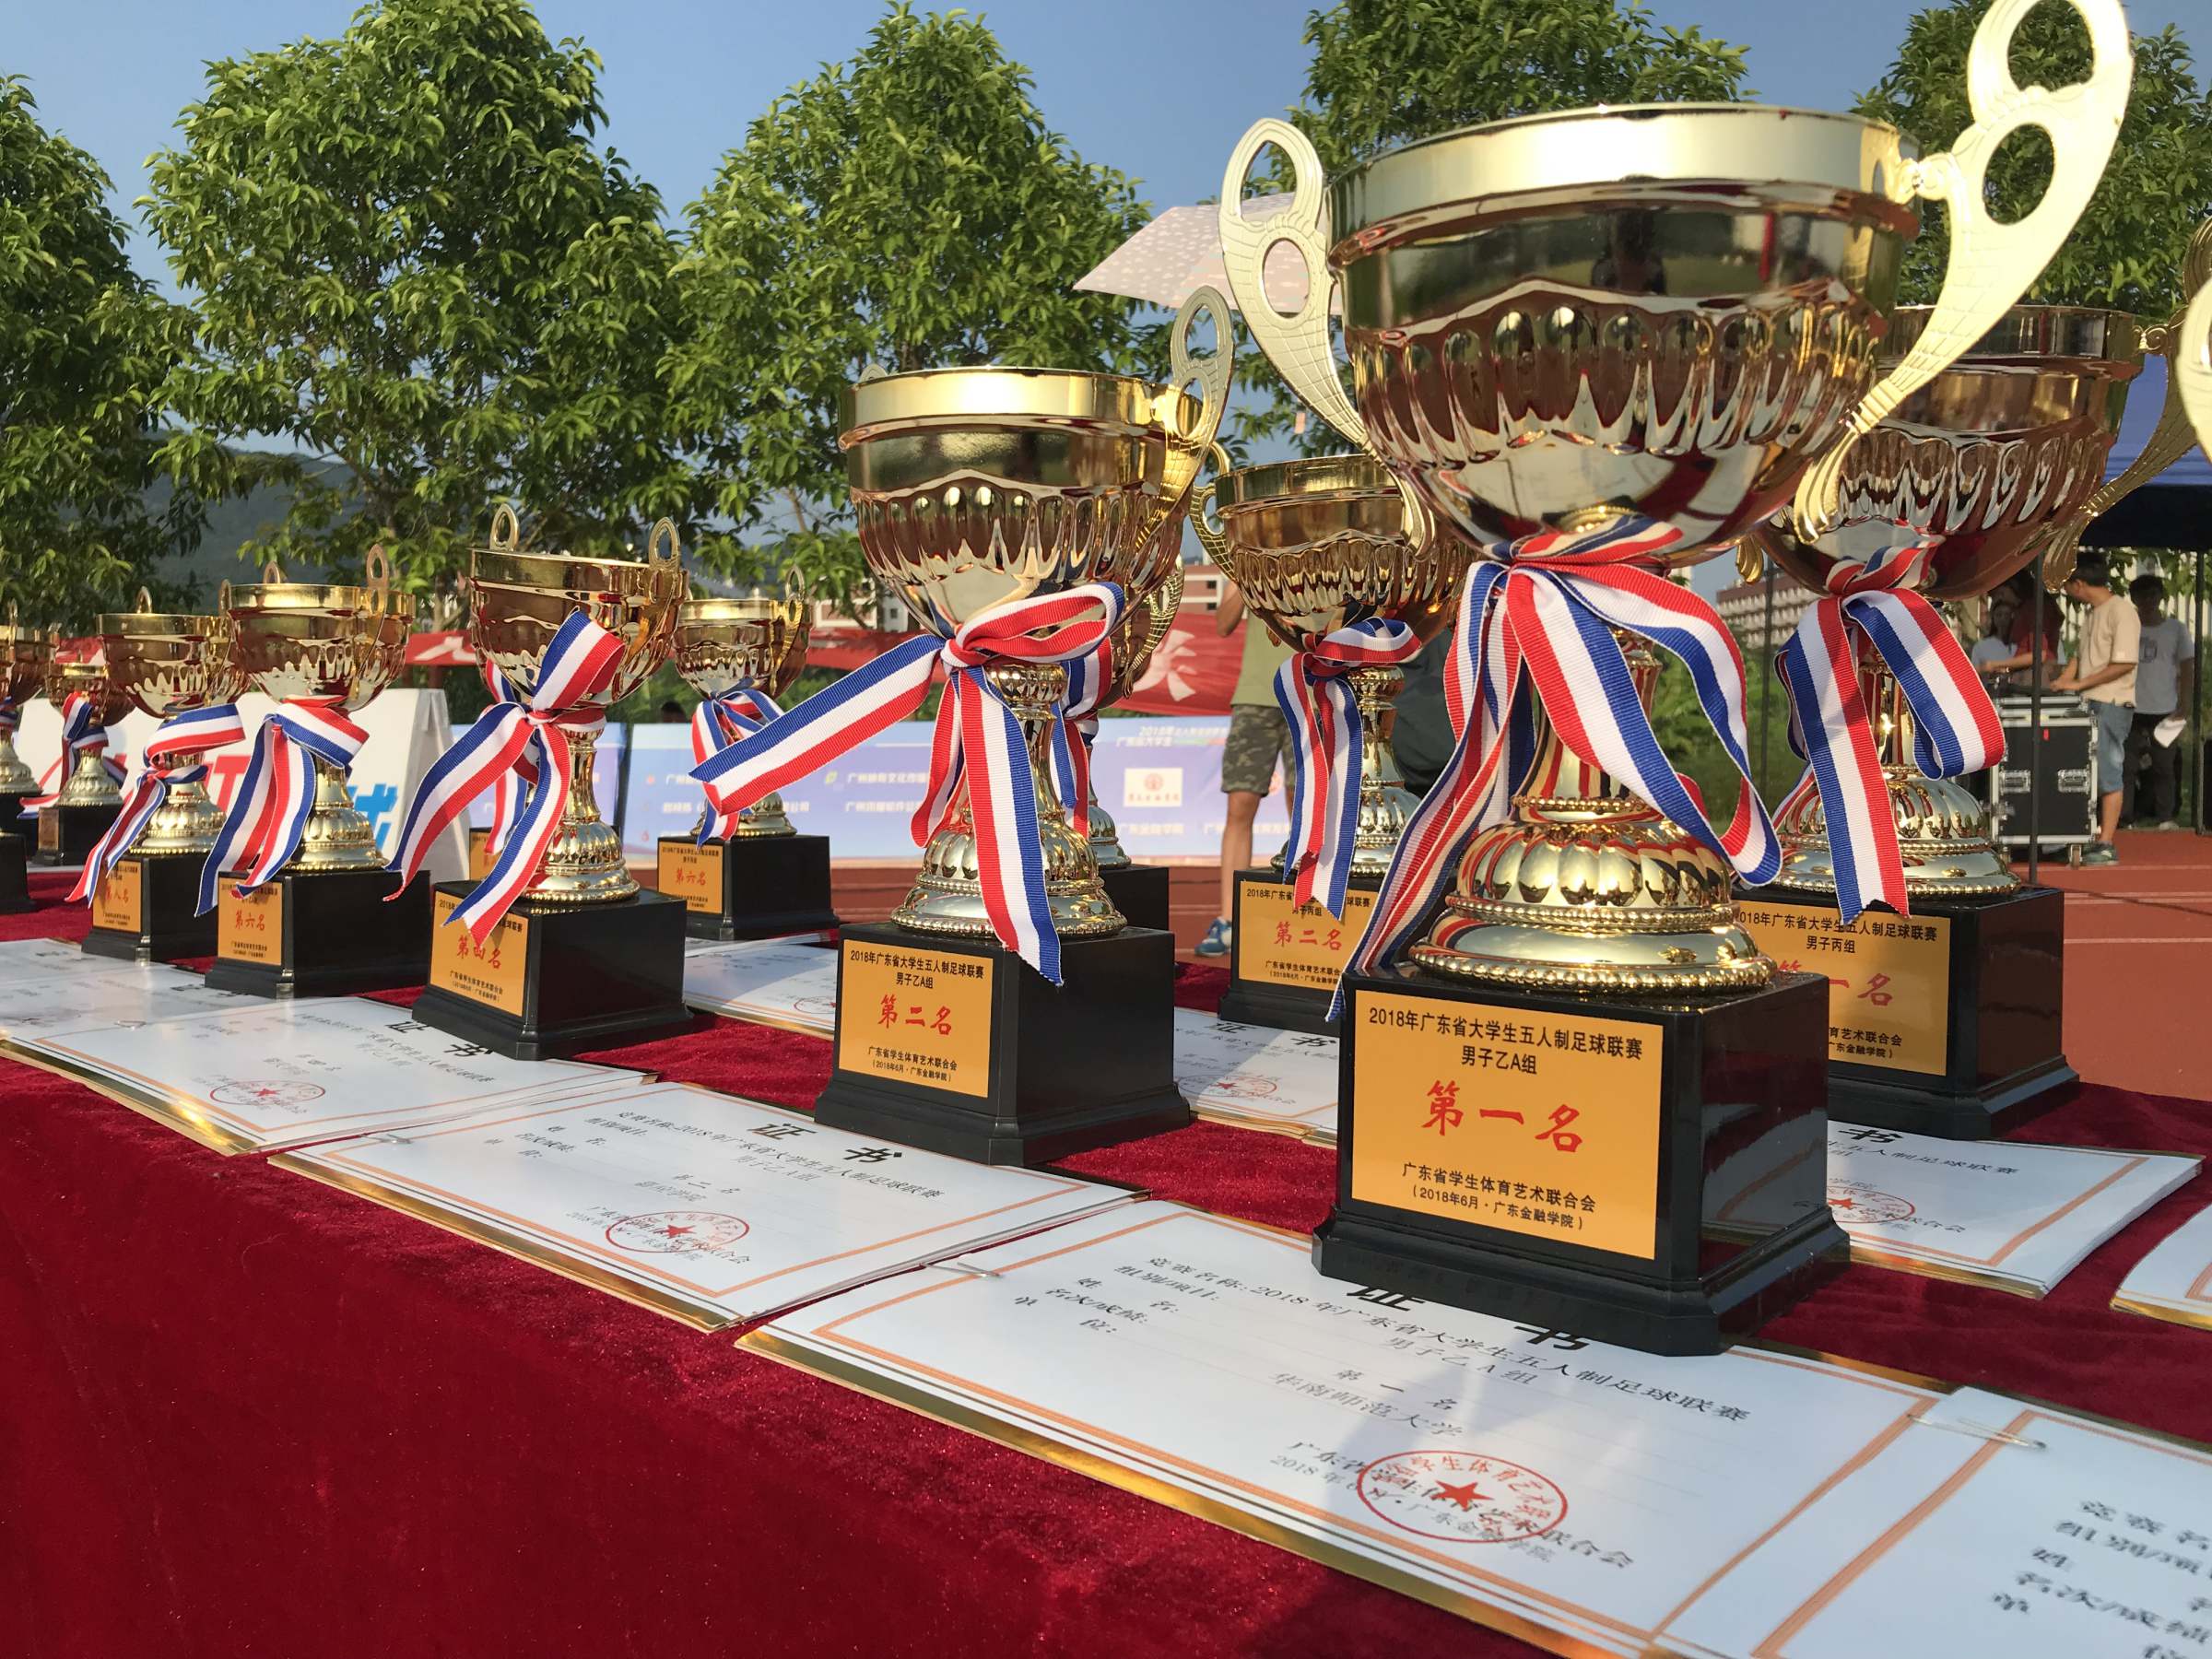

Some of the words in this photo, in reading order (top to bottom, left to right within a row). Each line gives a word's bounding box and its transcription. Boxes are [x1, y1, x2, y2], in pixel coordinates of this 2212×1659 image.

[676, 866, 708, 886] 第六名
[235, 909, 265, 931] 第六名
[1274, 921, 1342, 950] 第二名
[456, 934, 501, 970] 第四名
[1806, 935, 1855, 954] 男子丙组
[850, 949, 985, 980] 2018年广东省大学生五人制足球联赛
[896, 971, 934, 989] 男子乙A组
[1778, 960, 1893, 1006] 一名
[877, 993, 952, 1036] 第二名
[1369, 1006, 1643, 1061] 2018年广东省大学生五人制足球联赛
[868, 1045, 958, 1072] 广东省学生体育艺术联合会
[1462, 1044, 1537, 1076] 男子乙A组
[1421, 1079, 1583, 1153] 第一名
[1839, 1128, 1903, 1144] 书
[1402, 1162, 1596, 1213] 广东省学生体育艺术联合会
